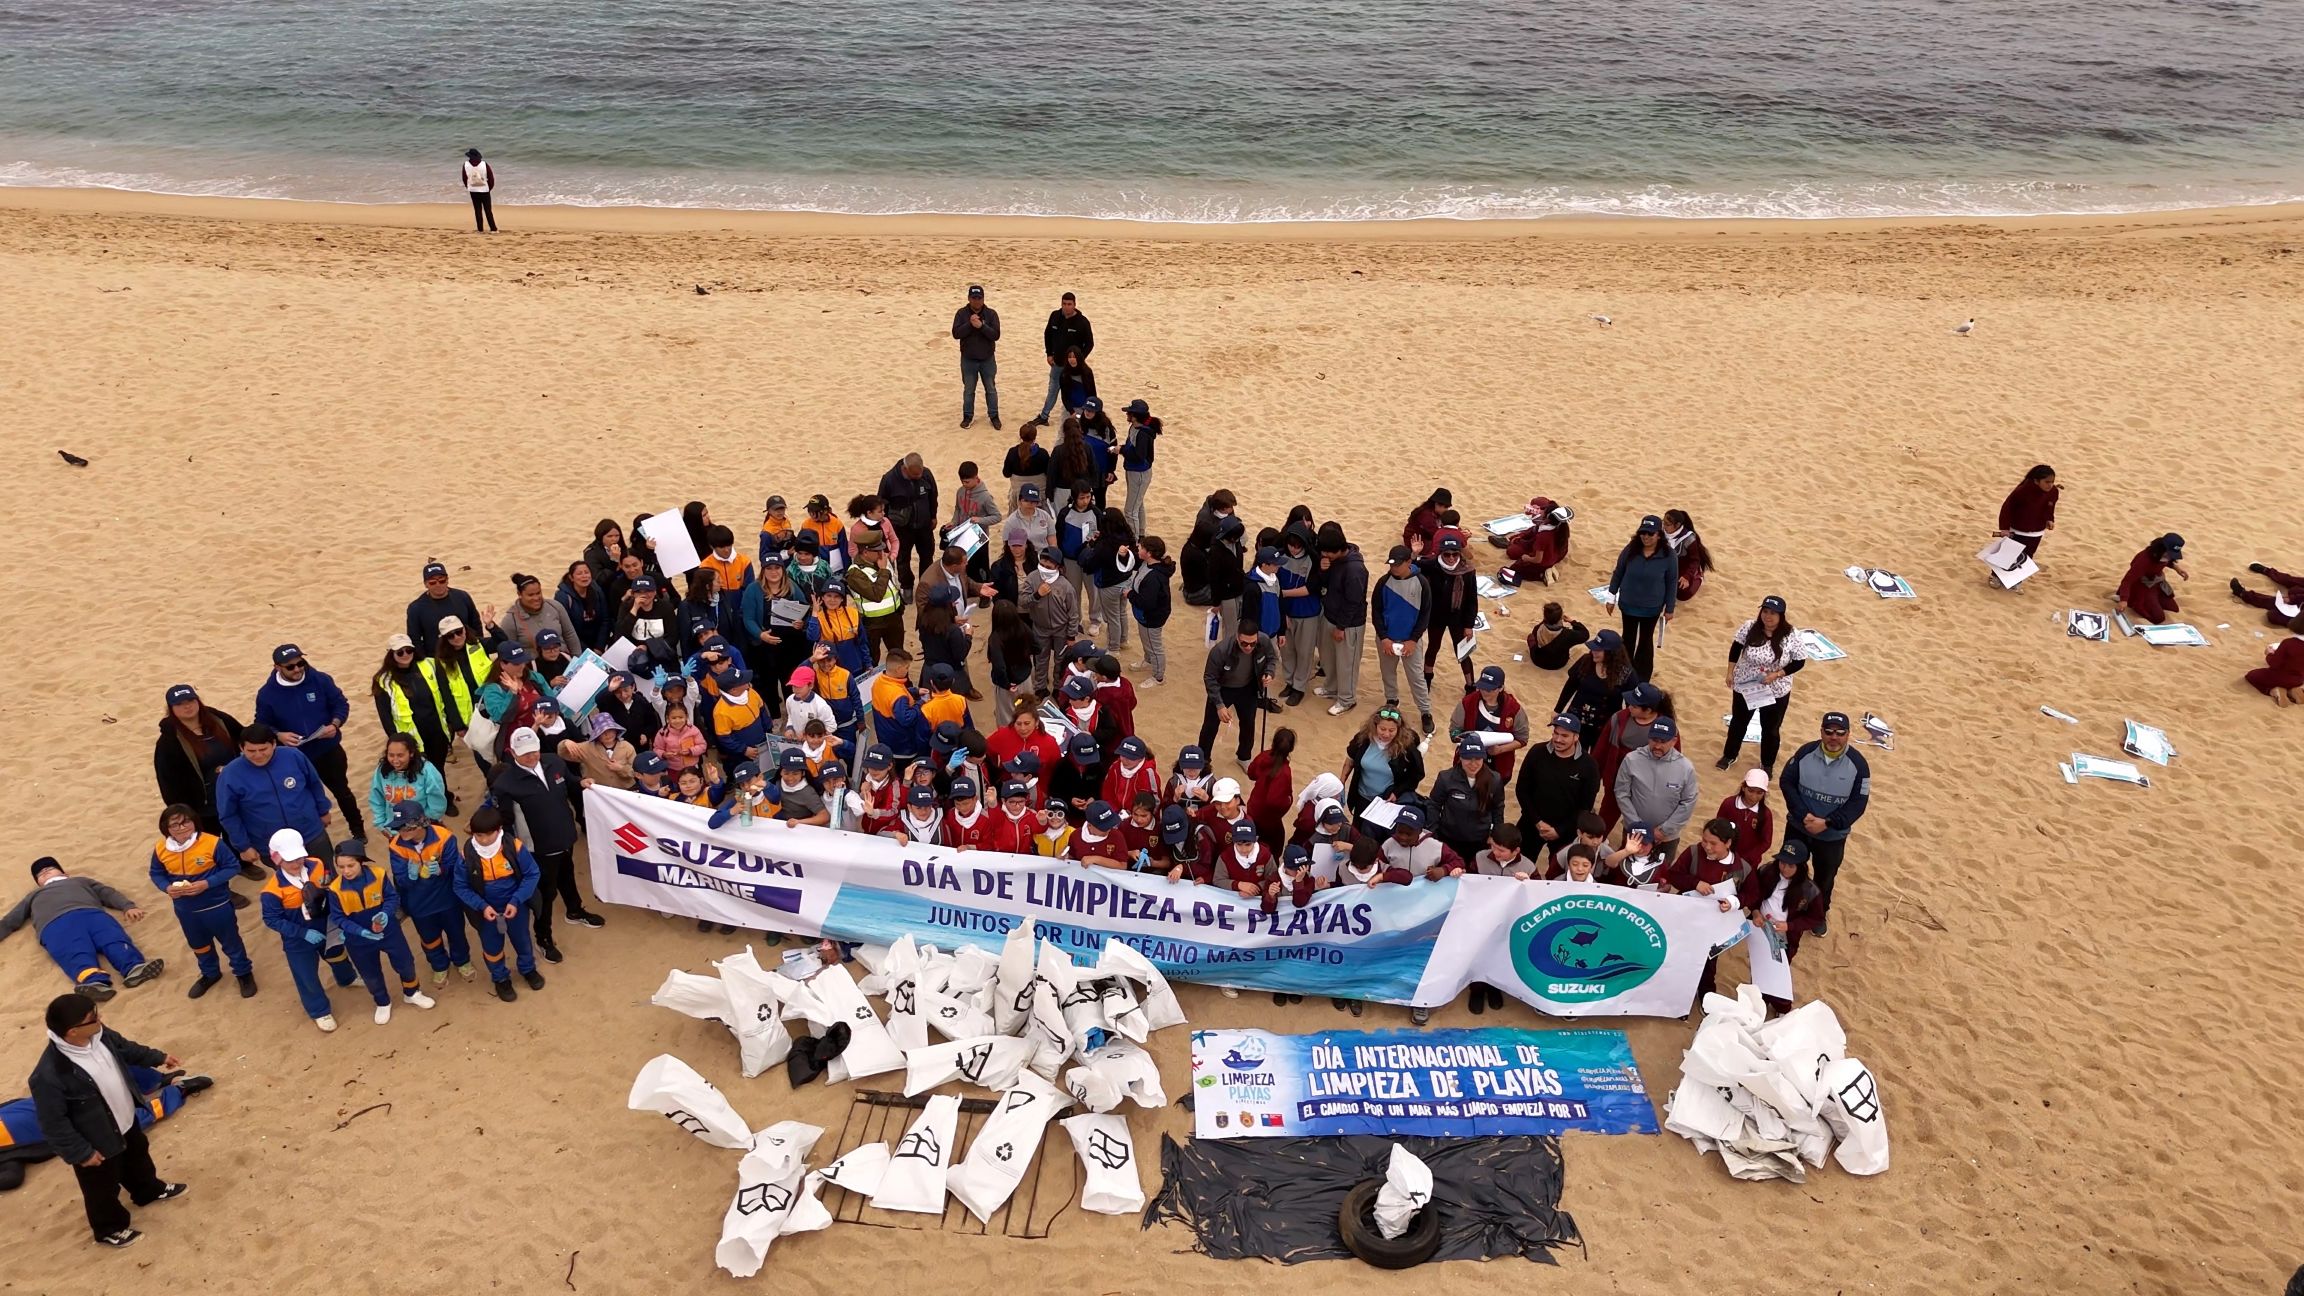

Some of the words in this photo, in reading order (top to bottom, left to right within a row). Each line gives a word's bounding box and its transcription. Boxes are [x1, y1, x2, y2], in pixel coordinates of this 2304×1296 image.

[1815, 793, 1833, 803] THE
[656, 837, 804, 878] SUZUKI
[657, 865, 756, 902] MARINE
[902, 856, 962, 892] DÍA
[972, 868, 1014, 900] DE
[1026, 872, 1182, 923] LIMPIEZA
[1192, 901, 1235, 931] DE
[1247, 903, 1372, 937] PLAYAS
[927, 906, 1011, 935] JUNTOS
[1020, 920, 1063, 944] OR
[1071, 928, 1100, 950] UN
[1206, 947, 1256, 964] MÁS
[1265, 946, 1344, 965] LIMPIO
[1520, 903, 1562, 934] CLEAN
[1564, 899, 1616, 913] OCEAN
[1617, 906, 1662, 949] PROJECT
[1547, 983, 1606, 994] SUZUKI
[1311, 1038, 1346, 1070] DÍA
[1354, 1044, 1509, 1069] INTERNACIONAL
[1516, 1043, 1545, 1067] DE
[1221, 1072, 1276, 1087] LIMPIEZA
[1229, 1086, 1272, 1101] PLAYAS
[1308, 1071, 1420, 1099] LIMPIEZA
[1430, 1070, 1464, 1098] DE
[1472, 1067, 1564, 1097] PLAYAS
[1303, 1103, 1316, 1118] EL
[1320, 1102, 1360, 1117] CAMBIO
[1363, 1101, 1385, 1118] POR
[1388, 1103, 1405, 1117] UN
[1408, 1104, 1433, 1117] MAR
[1436, 1101, 1460, 1117] MÁS
[1462, 1101, 1499, 1117] LIMPIO
[1502, 1101, 1546, 1117] EMPIEZA
[1548, 1103, 1572, 1118] POR
[1574, 1103, 1588, 1118] TI
